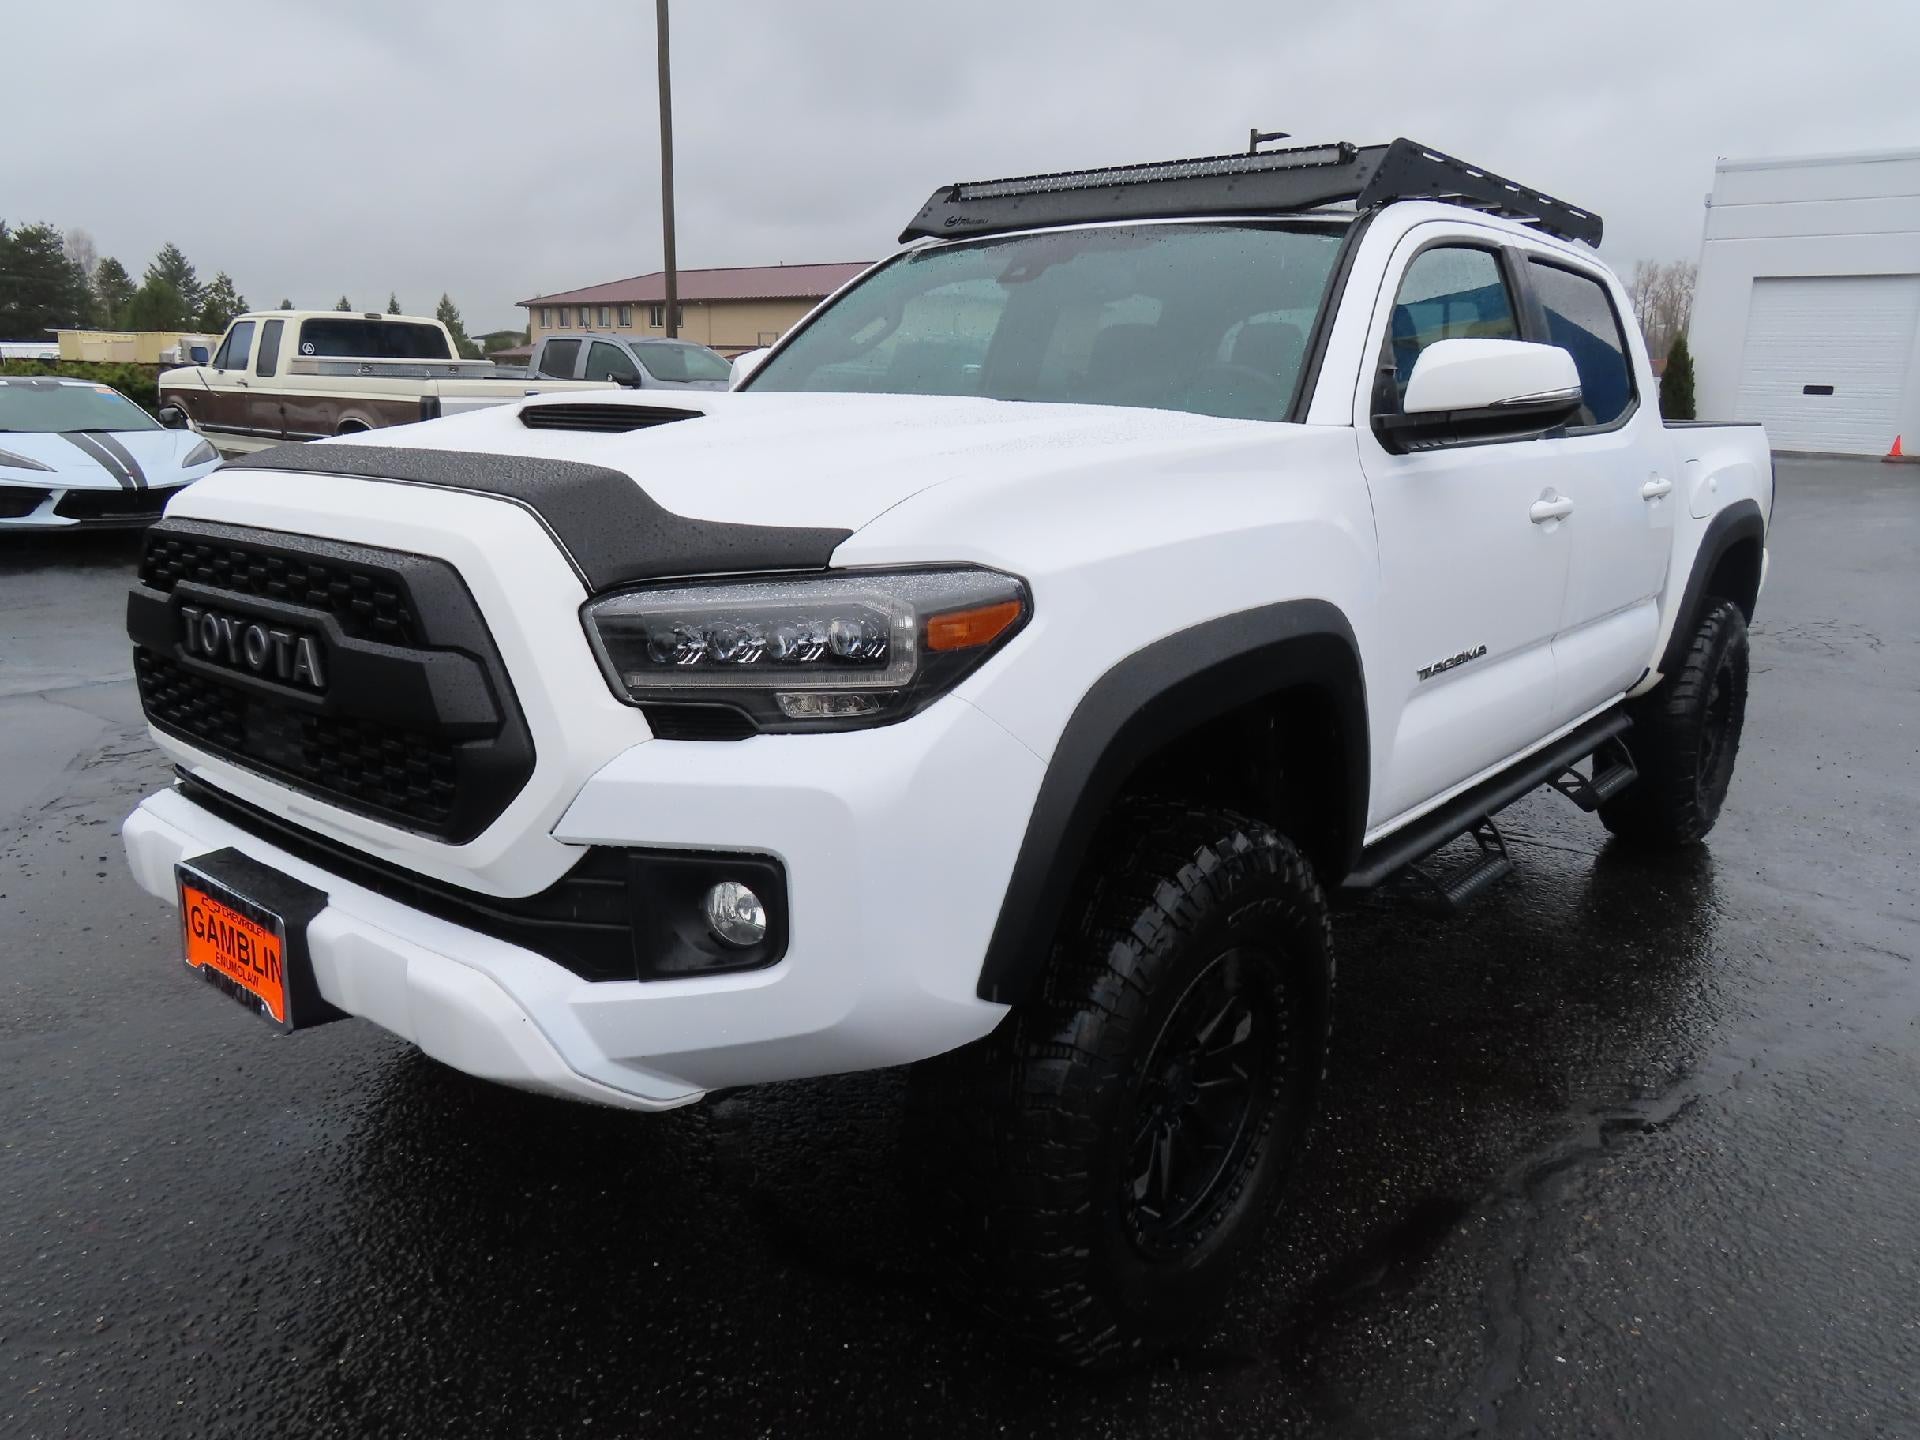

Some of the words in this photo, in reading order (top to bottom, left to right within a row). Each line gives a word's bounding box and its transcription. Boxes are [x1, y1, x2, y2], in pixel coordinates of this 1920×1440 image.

[182, 607, 324, 687] TOYOTA
[1416, 644, 1487, 682] TACOMA
[222, 906, 267, 940] CHEVROLET
[191, 905, 283, 987] GAMBLIN
[215, 951, 260, 987] ENUMCLAW
